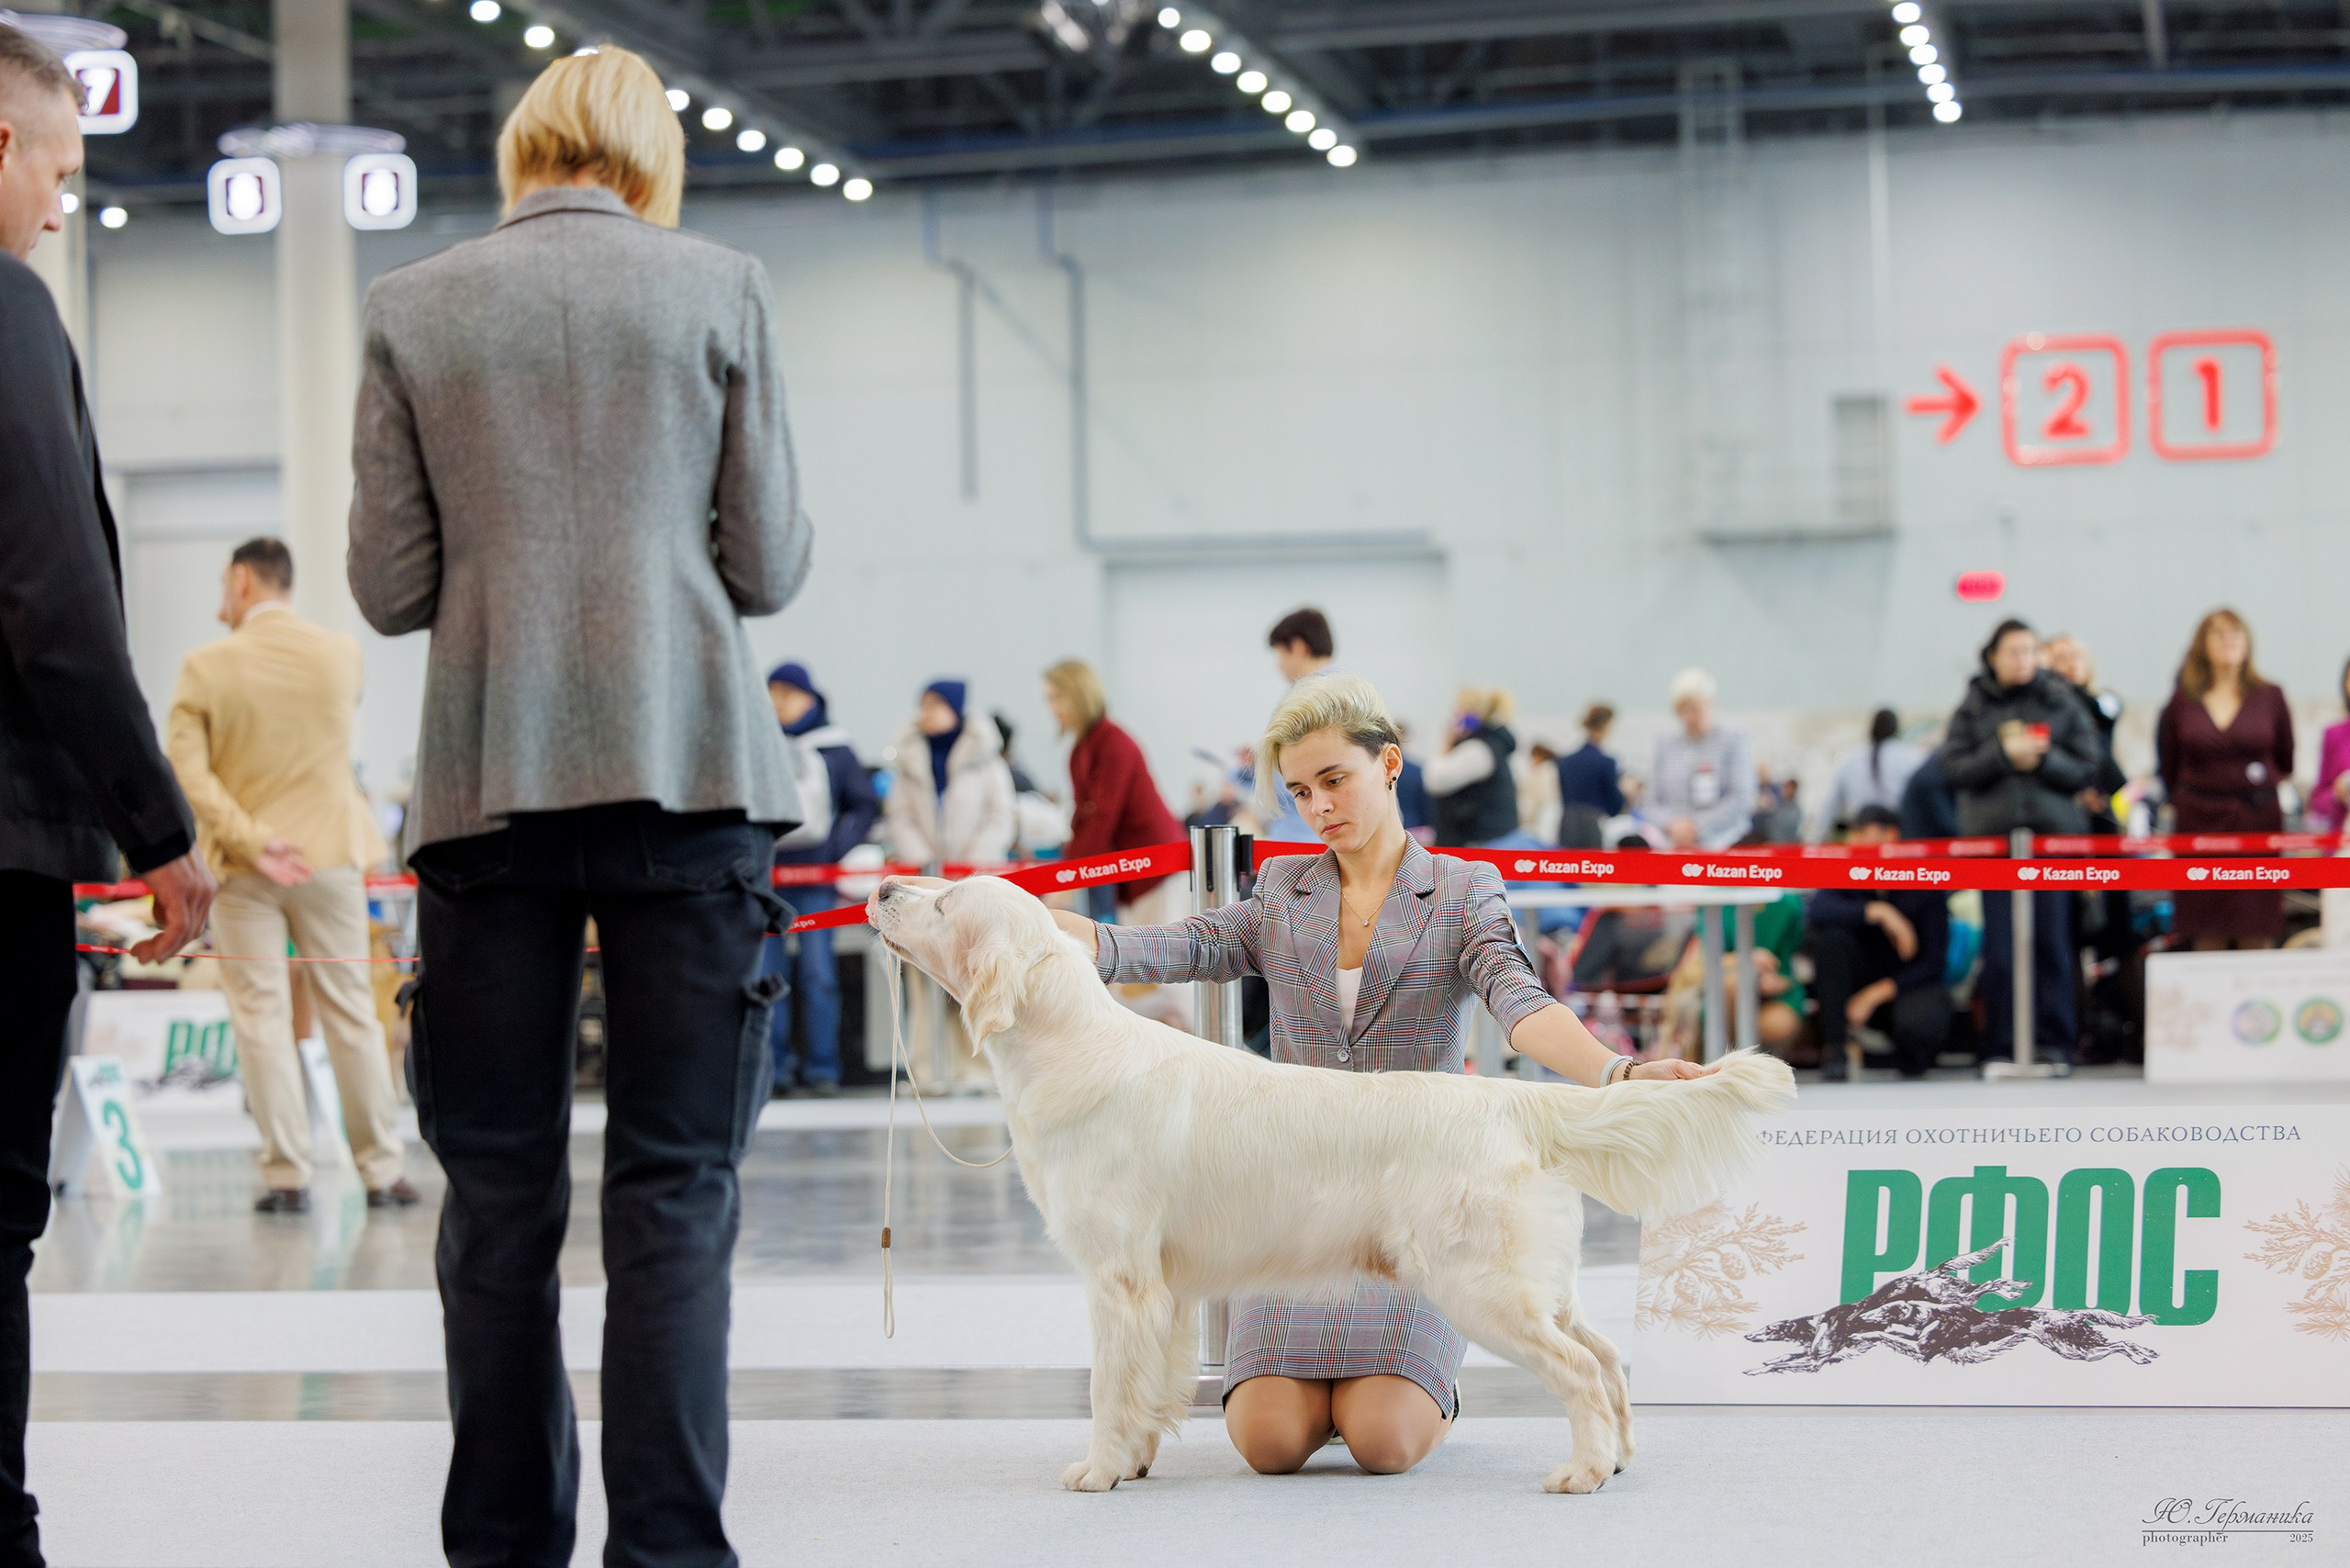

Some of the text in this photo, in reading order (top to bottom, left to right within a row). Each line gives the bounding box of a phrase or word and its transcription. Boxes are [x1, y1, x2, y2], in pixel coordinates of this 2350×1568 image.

[2043, 356, 2221, 440] 2 1
[1078, 856, 1152, 880] Kazan Expo
[1539, 859, 1615, 877] Kazan Expo
[1707, 864, 1783, 881] Kazan Expo
[1874, 867, 1951, 884] Kazan Expo
[2042, 867, 2120, 883] Kazan Expo
[2212, 867, 2290, 883] Kazan Expo
[103, 1100, 143, 1190] 3
[1756, 1125, 2302, 1147] ФЕДЕРАЦИЯ ОХОТНИЧЬЕГО СОБАКОВОДСТВА
[1840, 1165, 2221, 1326] РФОС
